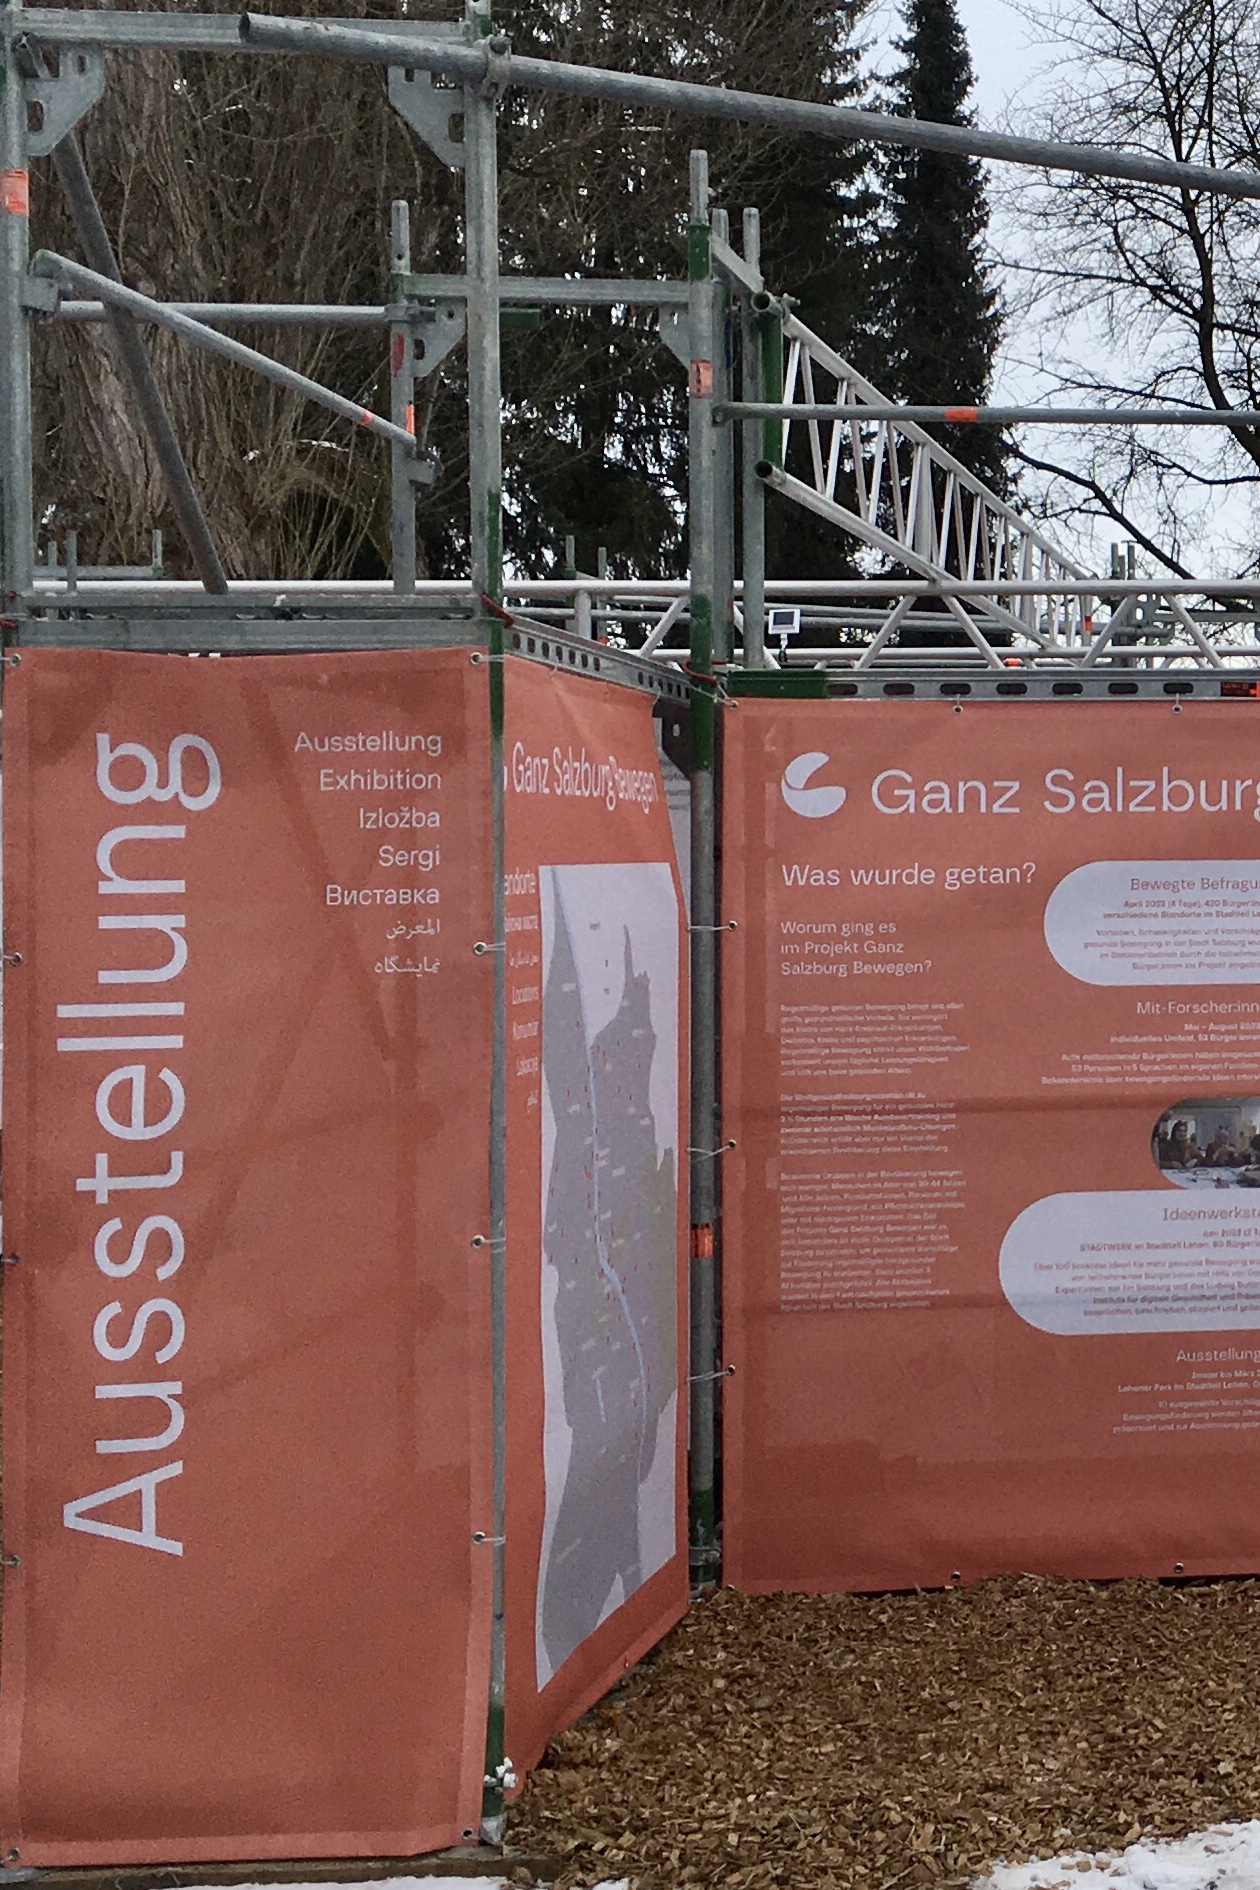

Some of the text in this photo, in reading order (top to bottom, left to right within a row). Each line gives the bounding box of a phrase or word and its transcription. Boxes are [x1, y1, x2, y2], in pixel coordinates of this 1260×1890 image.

[294, 730, 442, 757] Ausstellung
[319, 768, 441, 792] Exhibition
[513, 741, 551, 795] Ganz
[553, 745, 616, 812] Salzburg
[872, 769, 1021, 814] Ganz
[359, 806, 440, 829] Izložba
[378, 844, 441, 872] Sergi
[782, 862, 1037, 891] Was wurde getan?
[1130, 878, 1196, 893] Bewegte
[326, 884, 440, 905] Виставка
[386, 917, 441, 940] المعرض
[781, 921, 897, 936] Worum ging es
[781, 940, 904, 957] im Projekt Ganz
[781, 960, 932, 978] Salzburg Bewegen?
[56, 731, 222, 1557] Ausstellung
